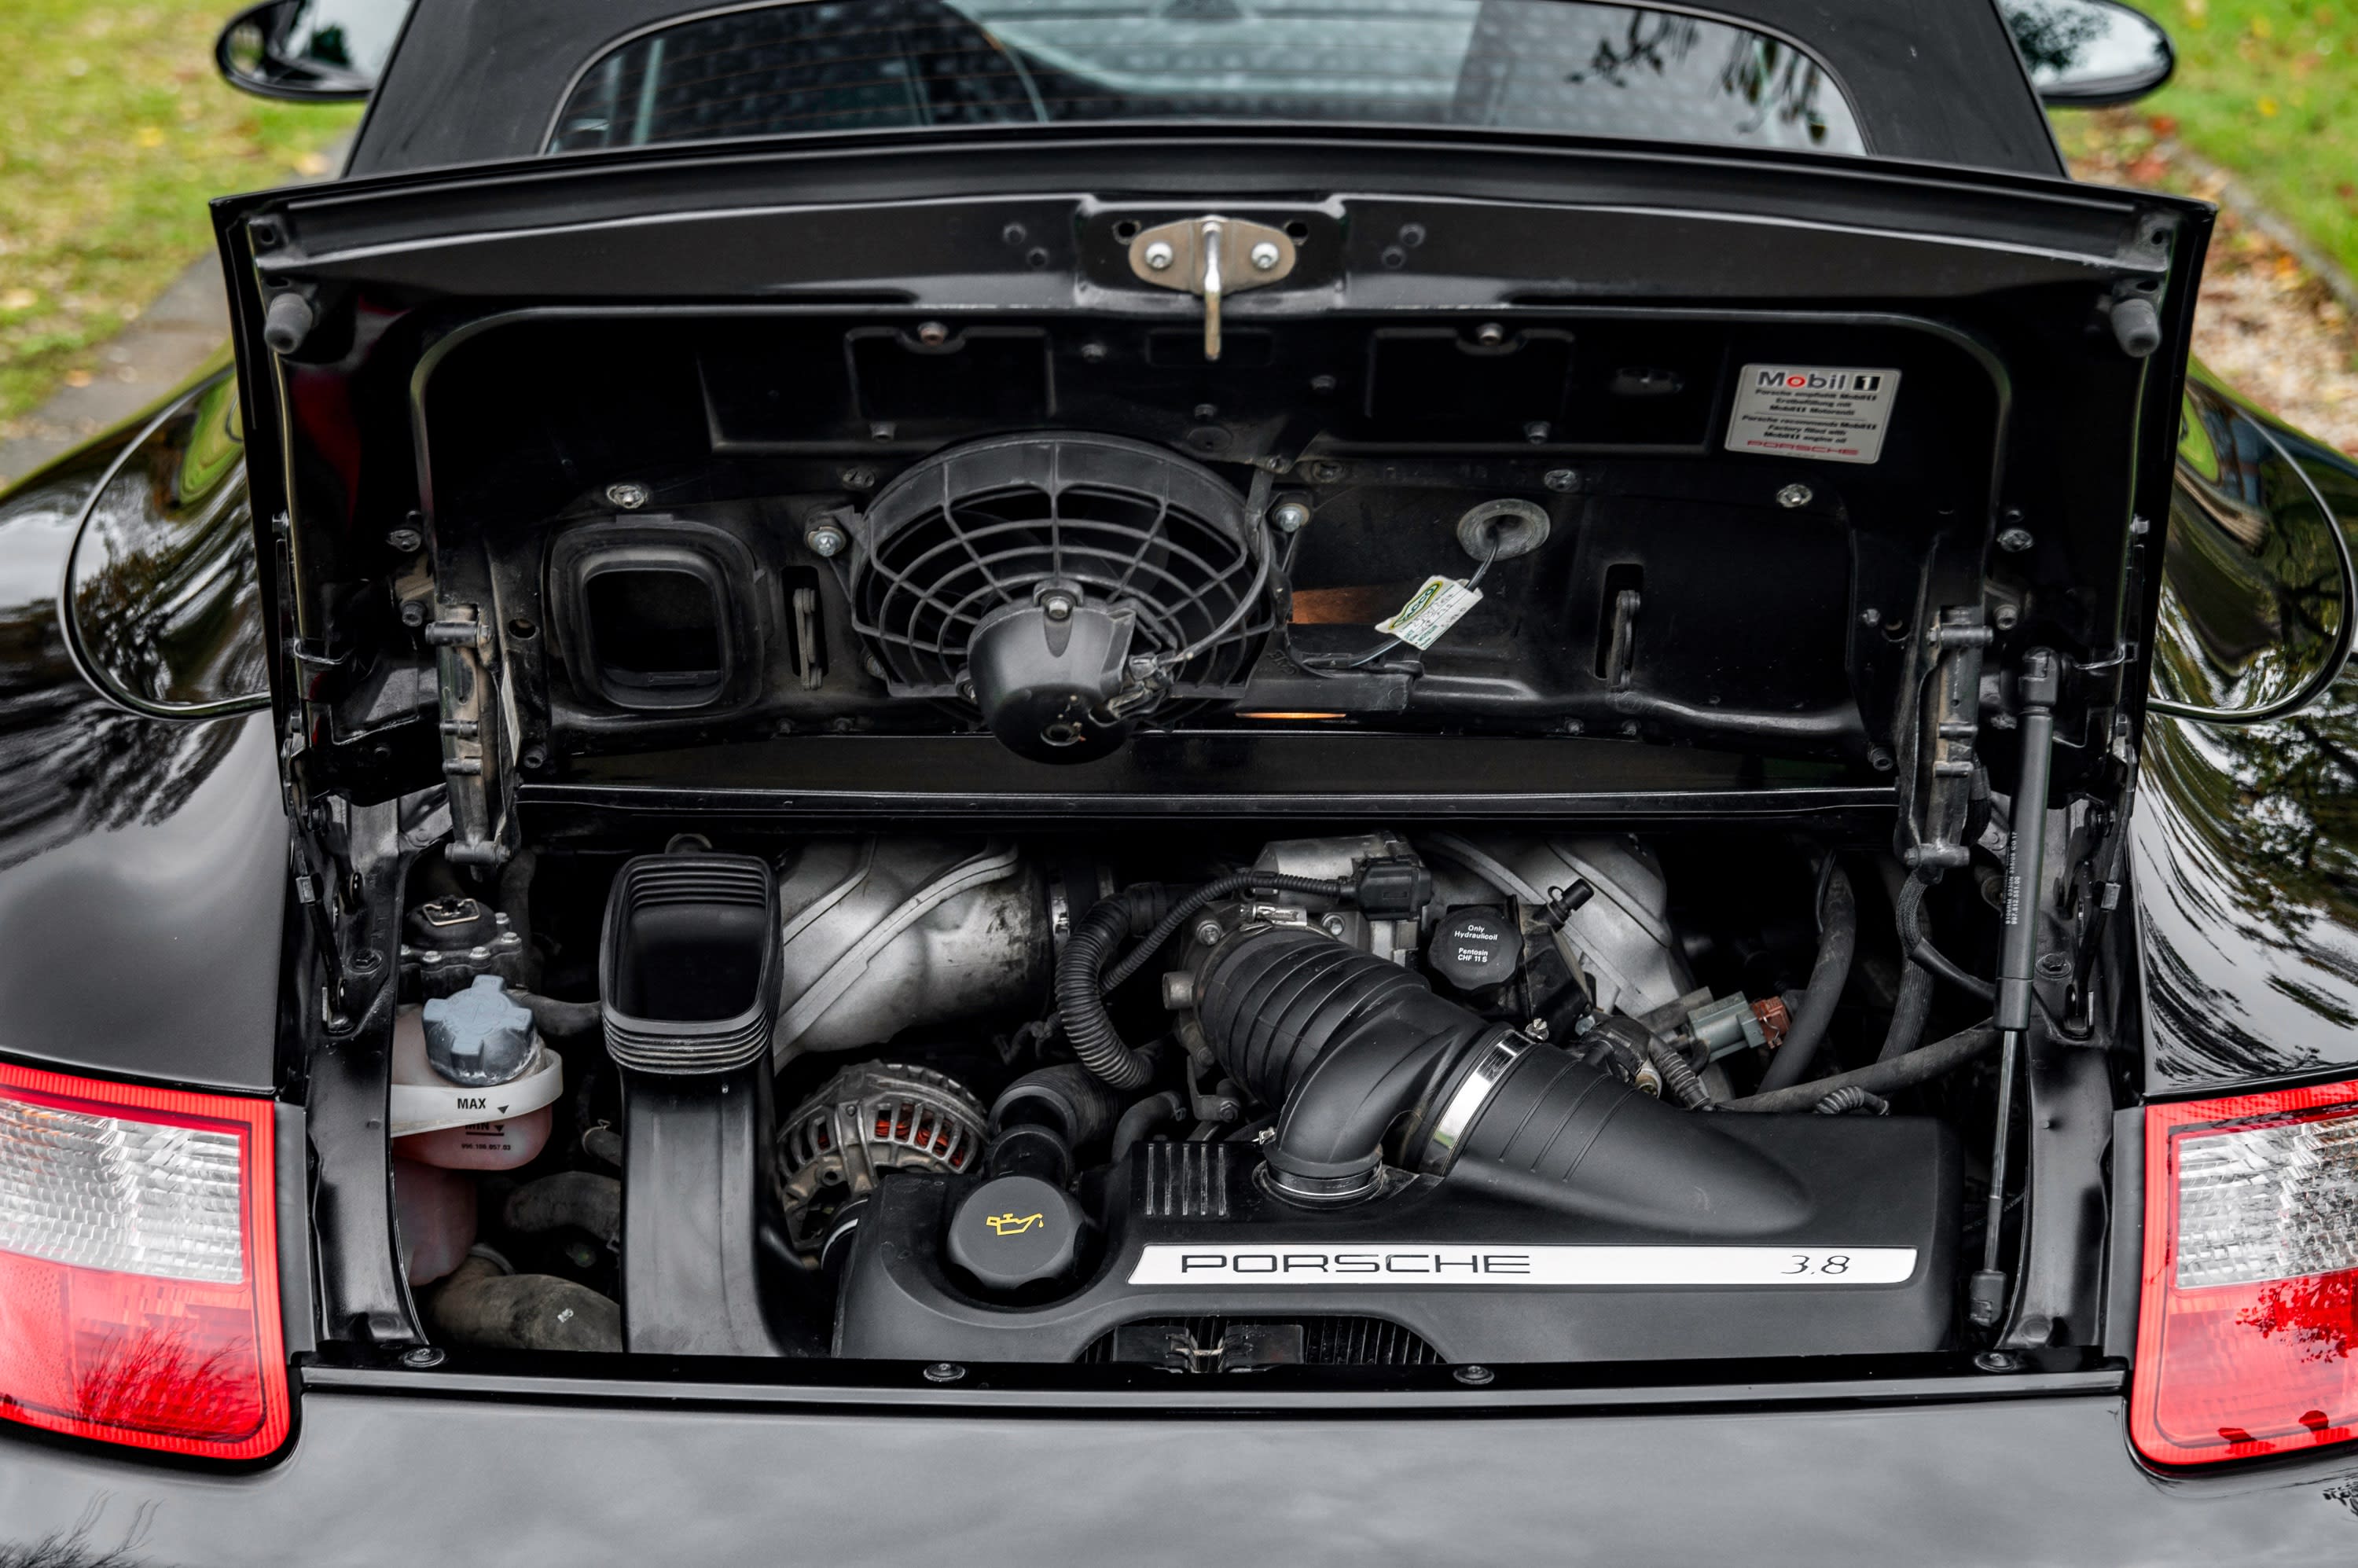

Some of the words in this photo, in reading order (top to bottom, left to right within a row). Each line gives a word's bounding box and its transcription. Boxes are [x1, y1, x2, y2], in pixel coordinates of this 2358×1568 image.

[1757, 371, 1846, 389] Mobil
[1768, 424, 1802, 433] Factory
[1780, 419, 1838, 428] recommends
[1747, 440, 1860, 455] PORSCHE
[1467, 924, 1485, 934] Only
[1454, 931, 1498, 941] Hydraulicoil
[1458, 947, 1489, 957] Pentosin
[457, 1098, 487, 1110] MAX
[1181, 1254, 1530, 1274] PORSCHE
[1780, 1254, 1851, 1275] 3.8
